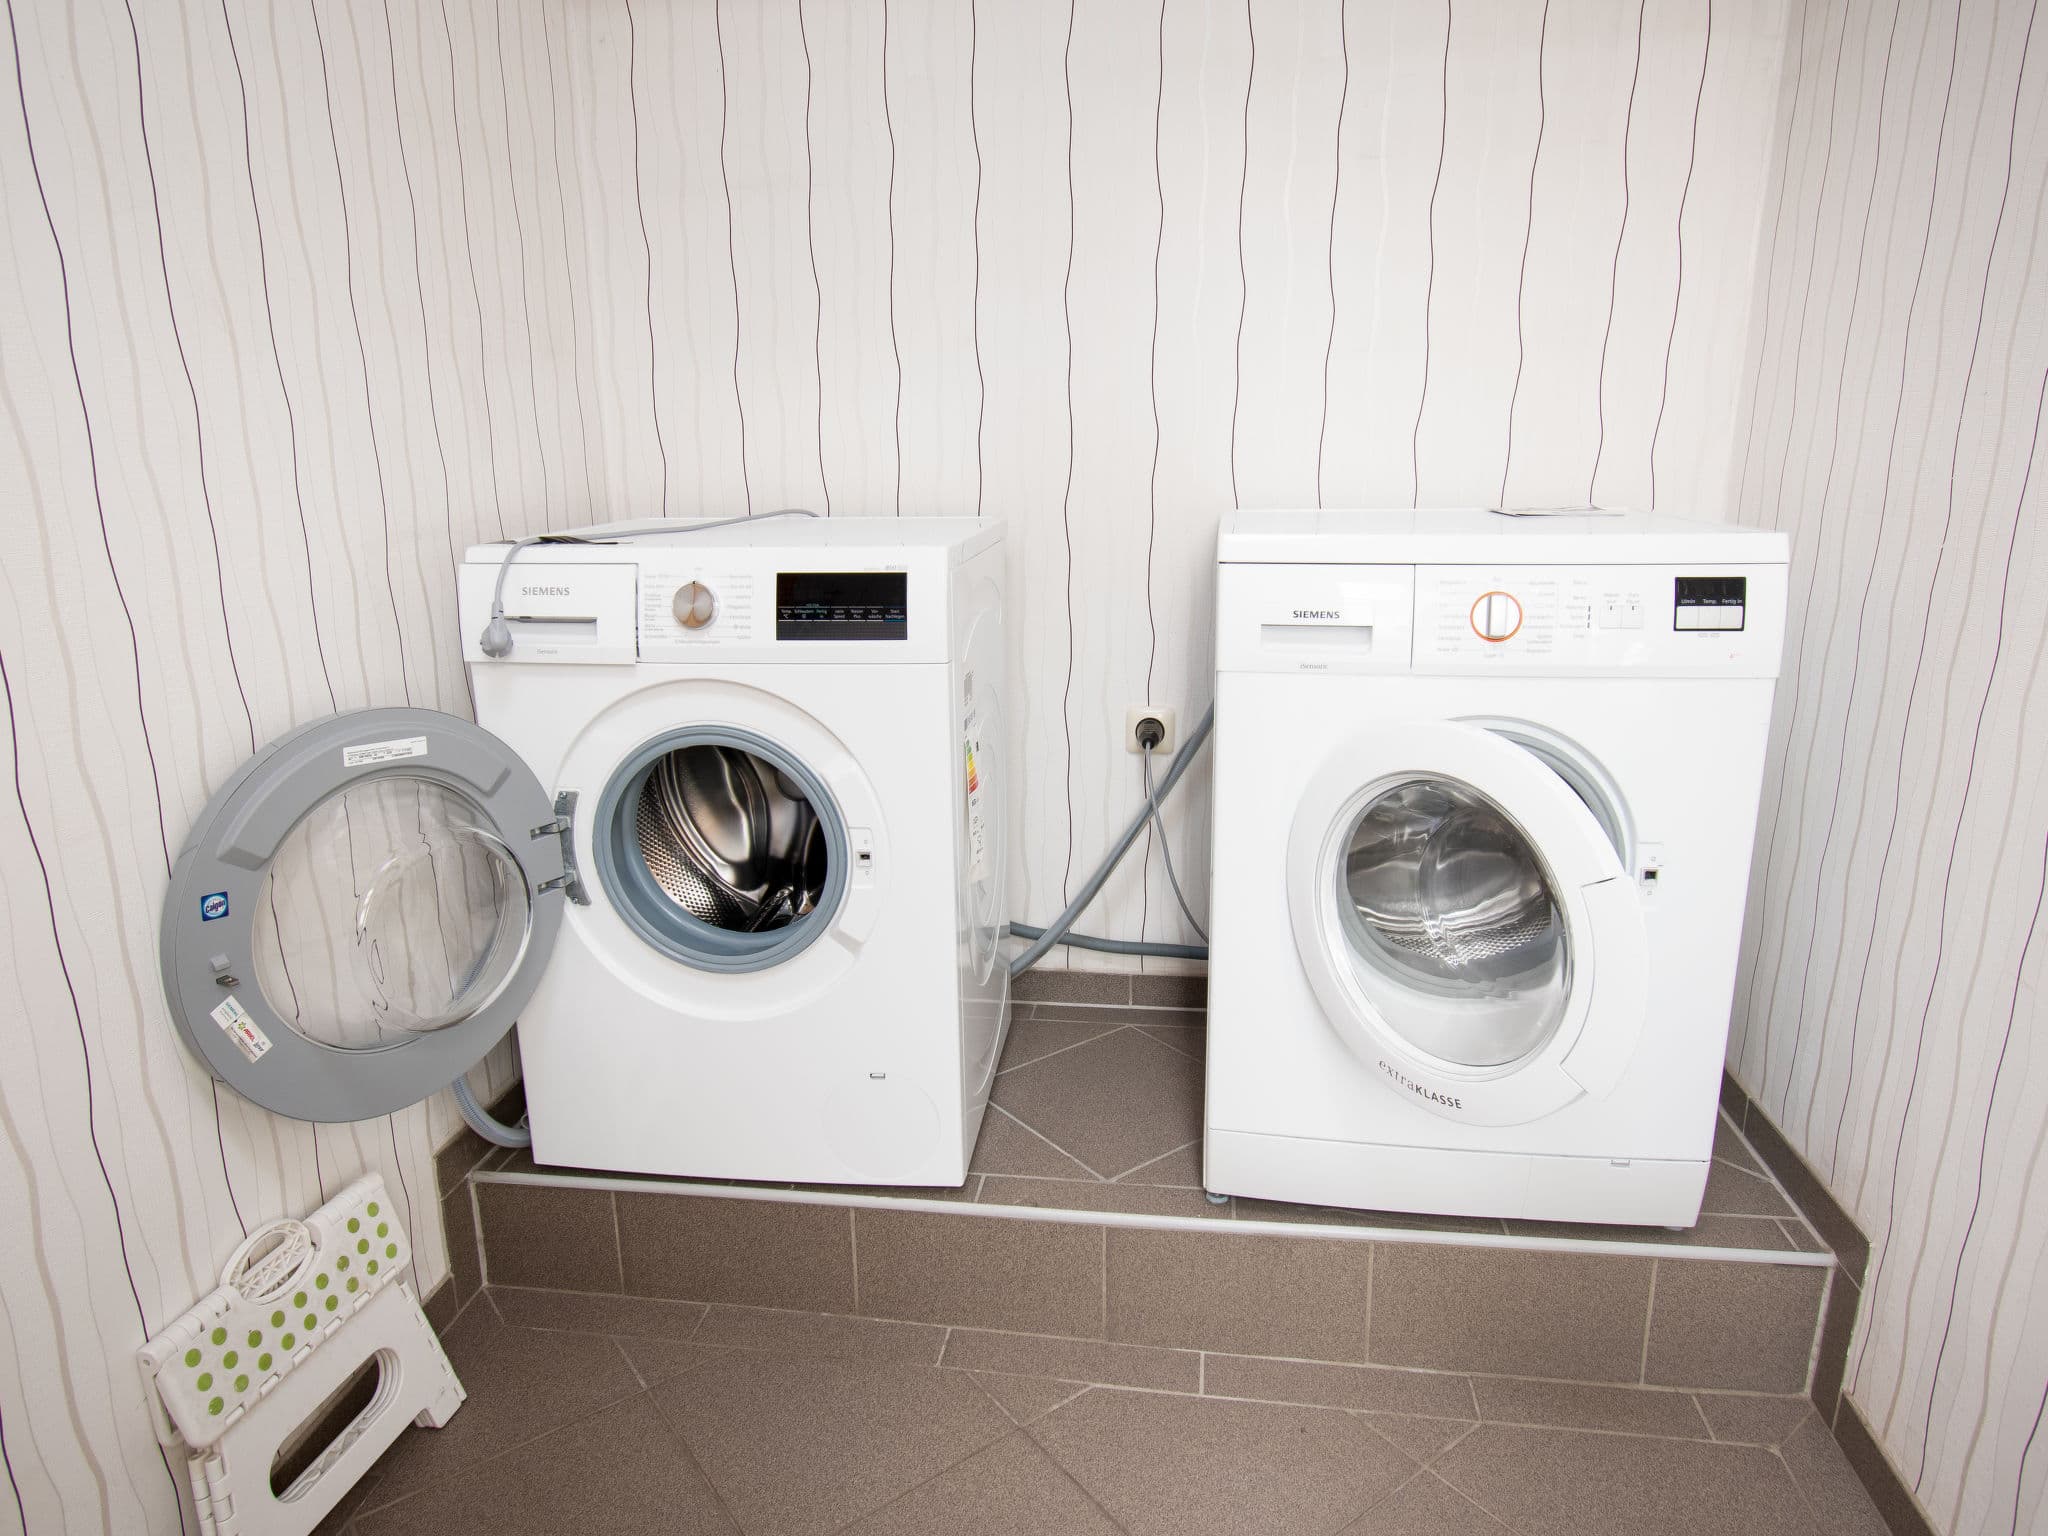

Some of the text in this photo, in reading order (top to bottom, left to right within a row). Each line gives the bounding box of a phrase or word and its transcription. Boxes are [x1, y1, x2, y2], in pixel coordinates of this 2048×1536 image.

[521, 587, 571, 596] SIEMENS
[1292, 610, 1341, 619] SIEMENS
[1378, 1060, 1463, 1109] extraKLASSE
